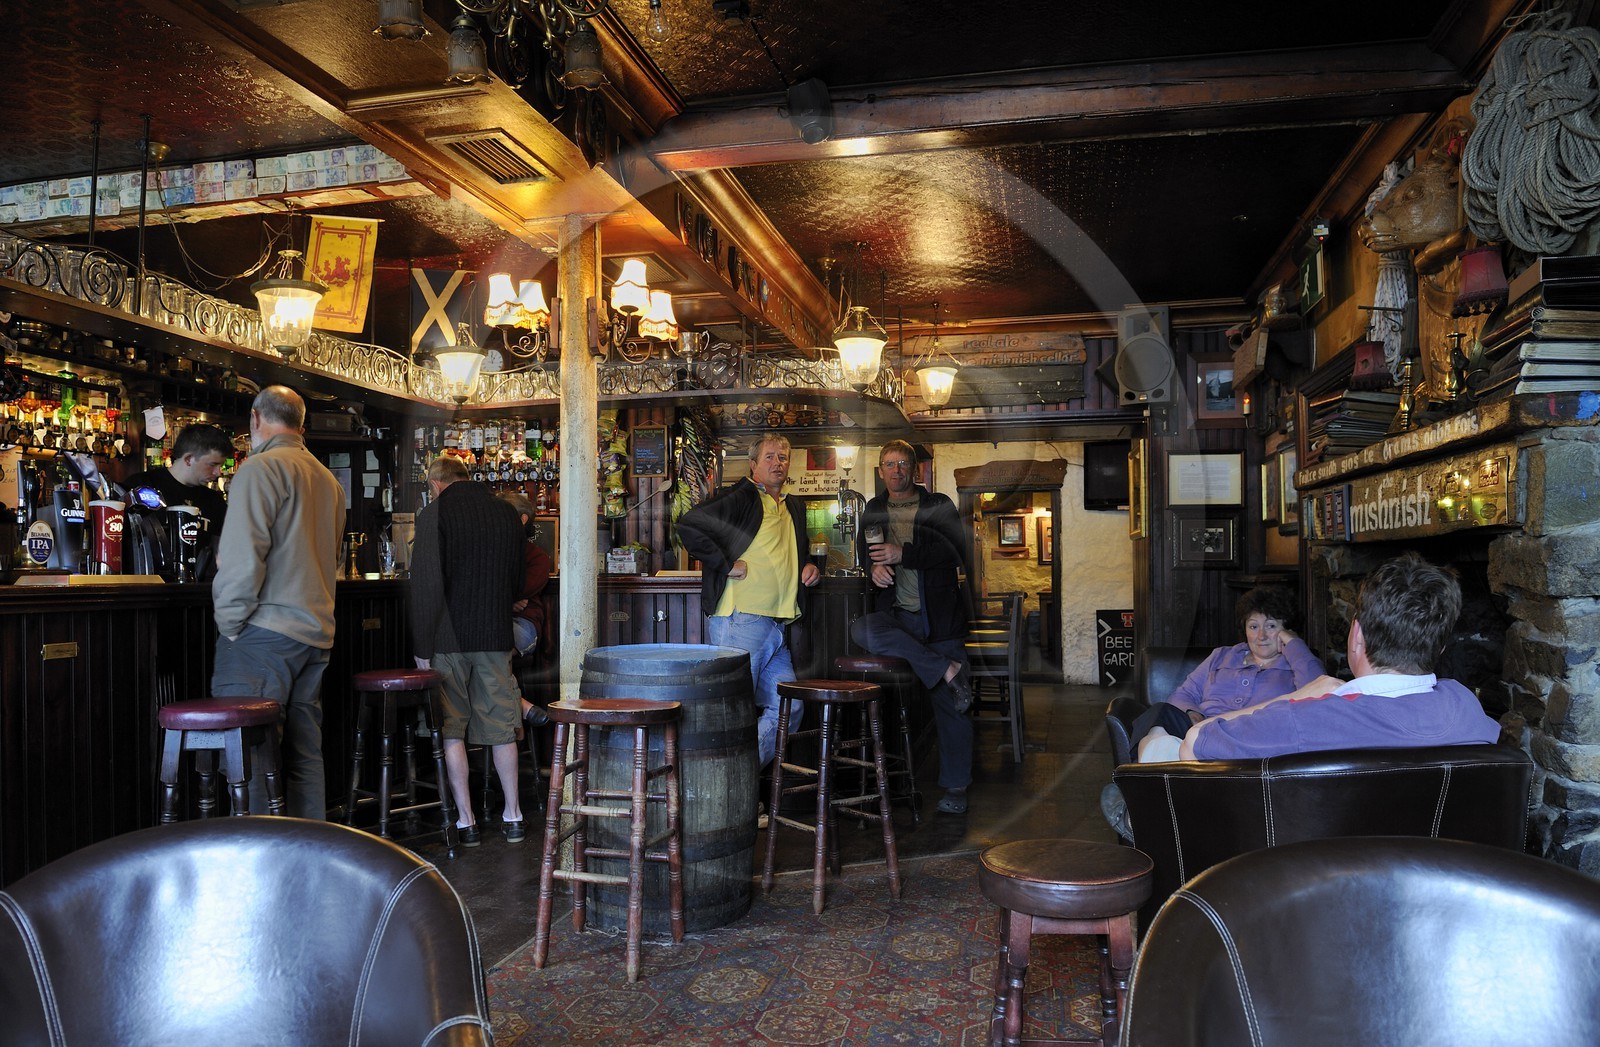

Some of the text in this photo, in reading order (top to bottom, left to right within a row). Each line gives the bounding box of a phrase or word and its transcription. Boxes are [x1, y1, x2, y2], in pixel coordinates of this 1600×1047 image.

[963, 335, 1020, 349] real ale
[979, 353, 1038, 366] mishnish
[138, 493, 160, 502] BEST
[1350, 475, 1431, 534] mishnish
[109, 522, 124, 532] 80
[32, 539, 50, 550] IPA
[1105, 636, 1133, 649] BEE
[1103, 652, 1135, 667] GARD
